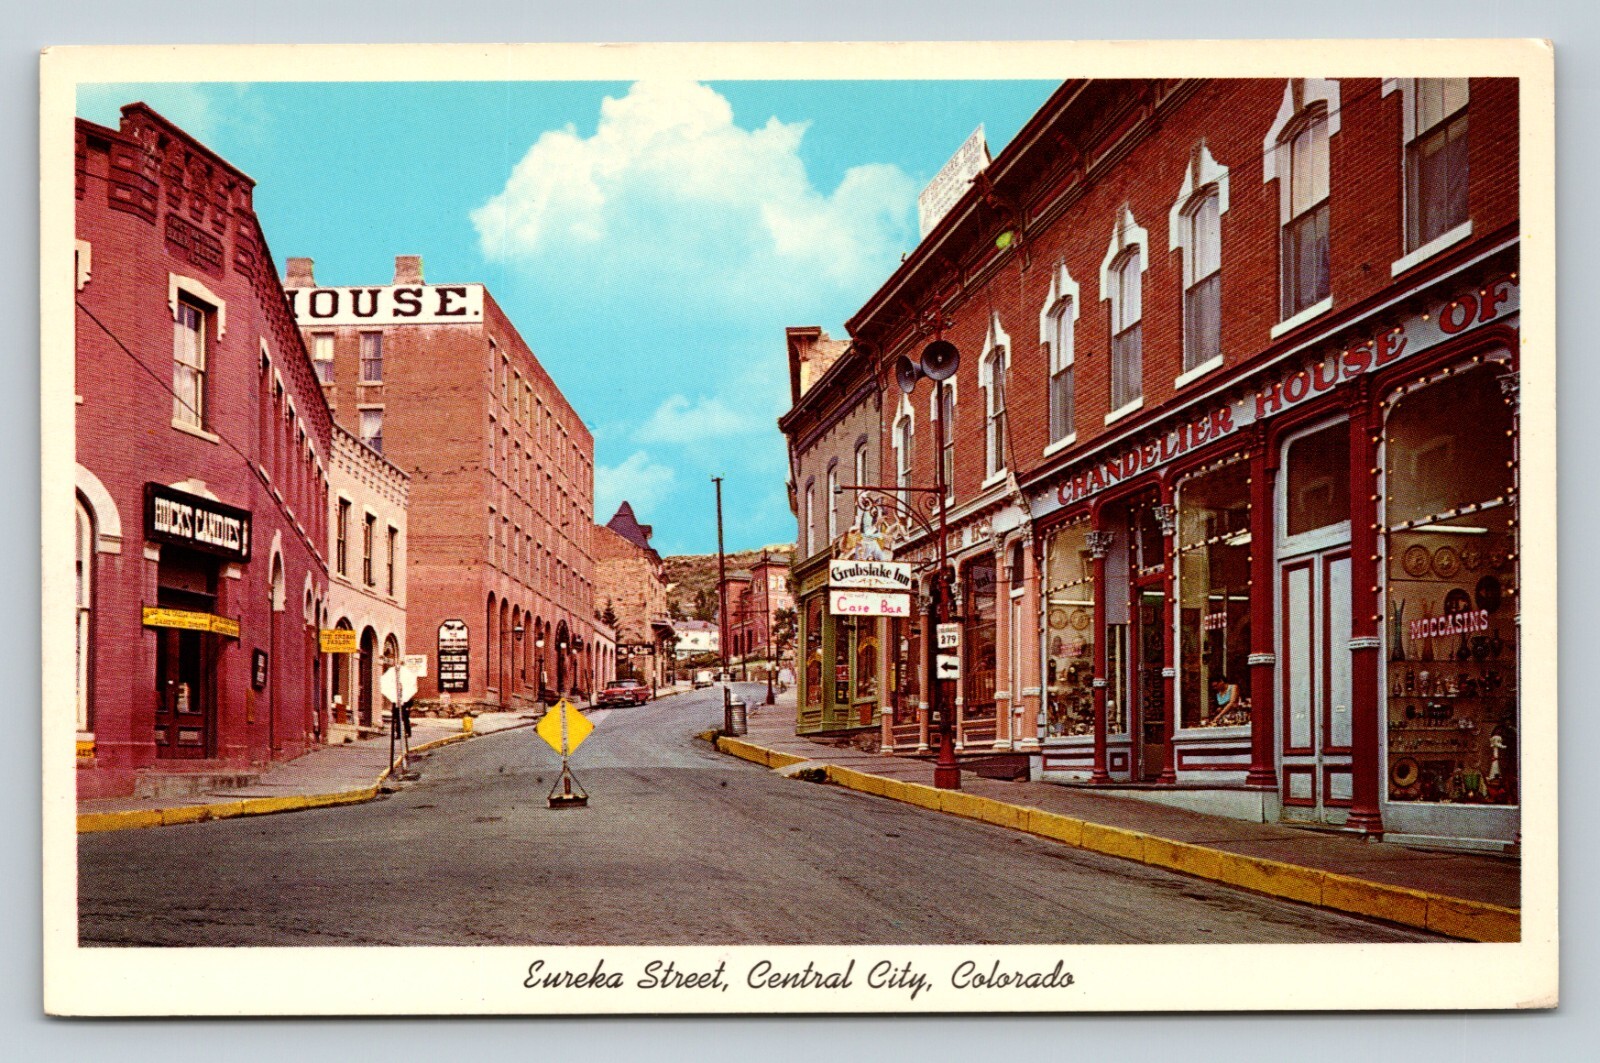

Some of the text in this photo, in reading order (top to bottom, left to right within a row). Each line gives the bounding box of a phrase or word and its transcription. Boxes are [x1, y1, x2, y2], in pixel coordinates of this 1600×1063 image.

[1057, 274, 1520, 505] CHANDELIER HOUSE OF
[831, 563, 910, 586] Grubstake Inn
[1204, 612, 1227, 631] GIFTS
[1410, 609, 1489, 640] MOCCASINS
